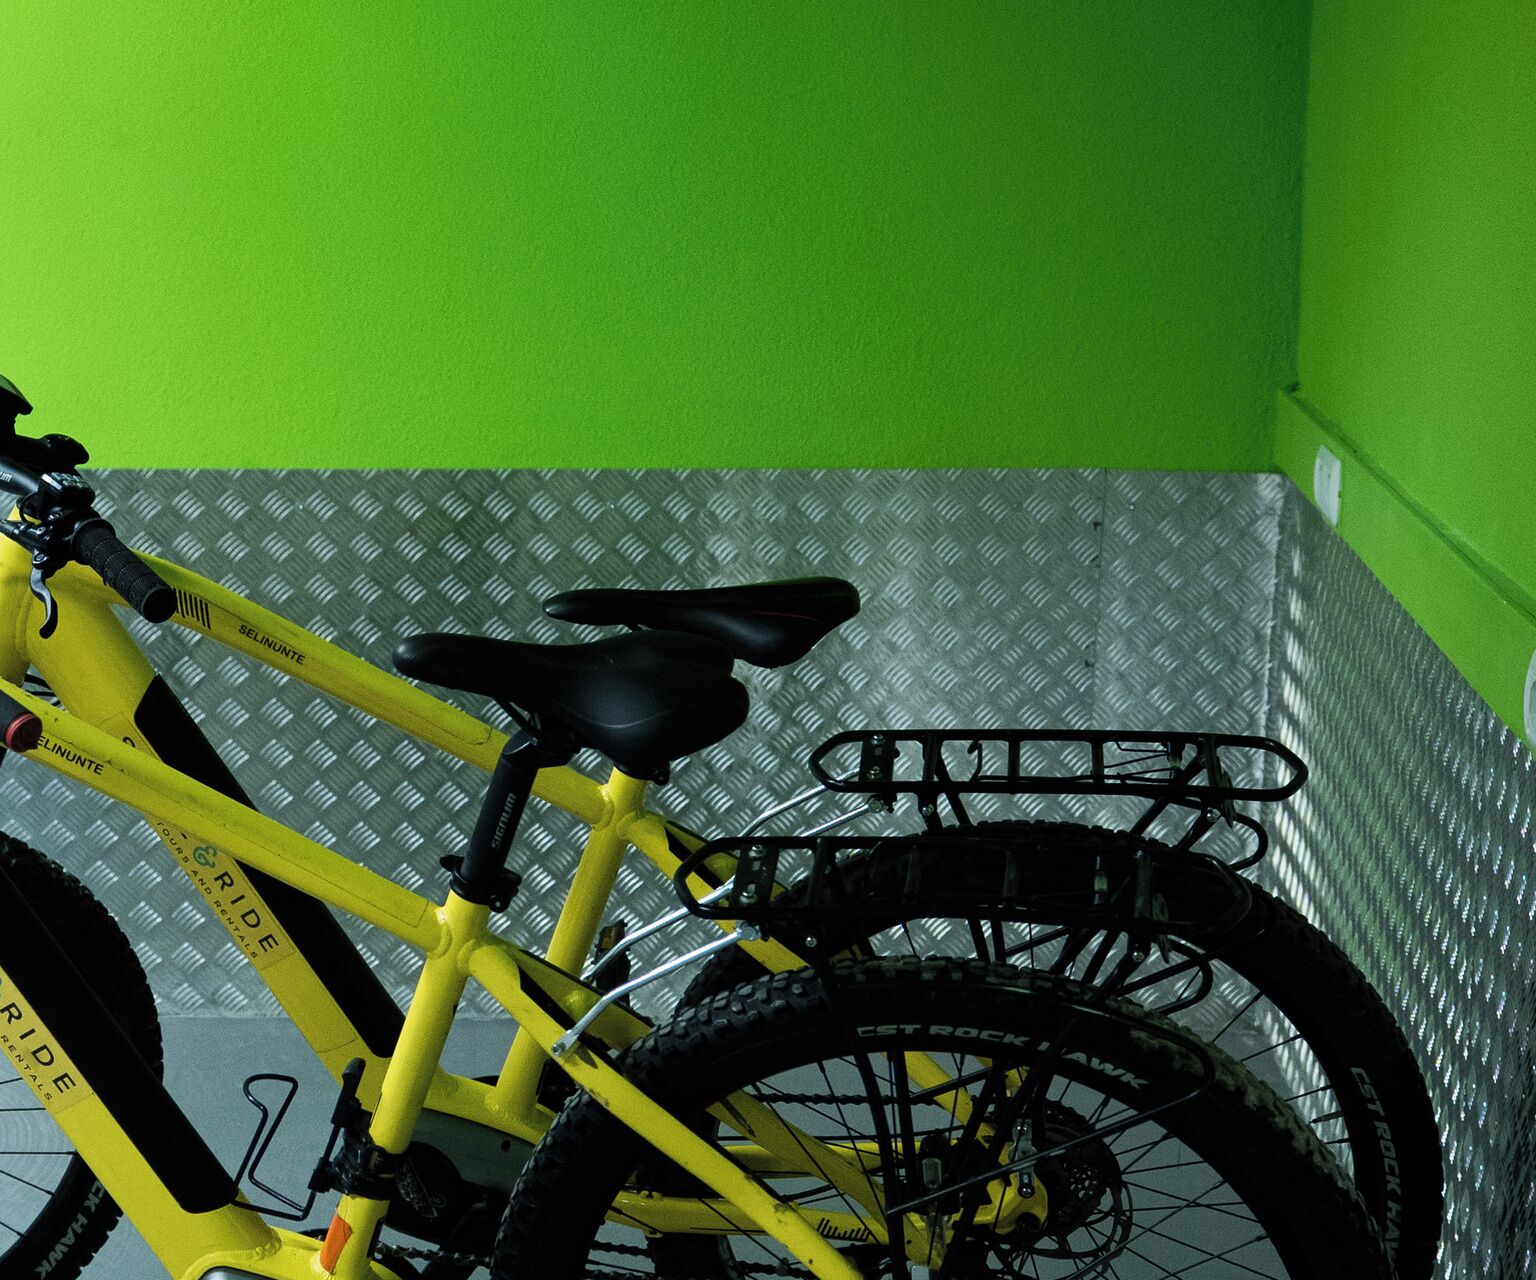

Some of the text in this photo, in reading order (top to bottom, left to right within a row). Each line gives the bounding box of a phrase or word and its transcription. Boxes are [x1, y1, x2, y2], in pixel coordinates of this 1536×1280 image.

[238, 624, 306, 665] SELINUNTE
[37, 735, 105, 775] ELINUNTE
[491, 792, 517, 848] SIGNUM
[192, 870, 212, 895] AND
[214, 900, 257, 958] RENTALS
[214, 871, 279, 952] RIDE
[0, 1002, 76, 1094] RIDE
[1, 1035, 52, 1100] RENTALS
[856, 1024, 921, 1039] CST
[928, 1024, 1032, 1047] ROCK
[1350, 1065, 1386, 1117] CST
[1374, 1120, 1403, 1196] ROCK
[34, 1180, 105, 1280] CK HAWK
